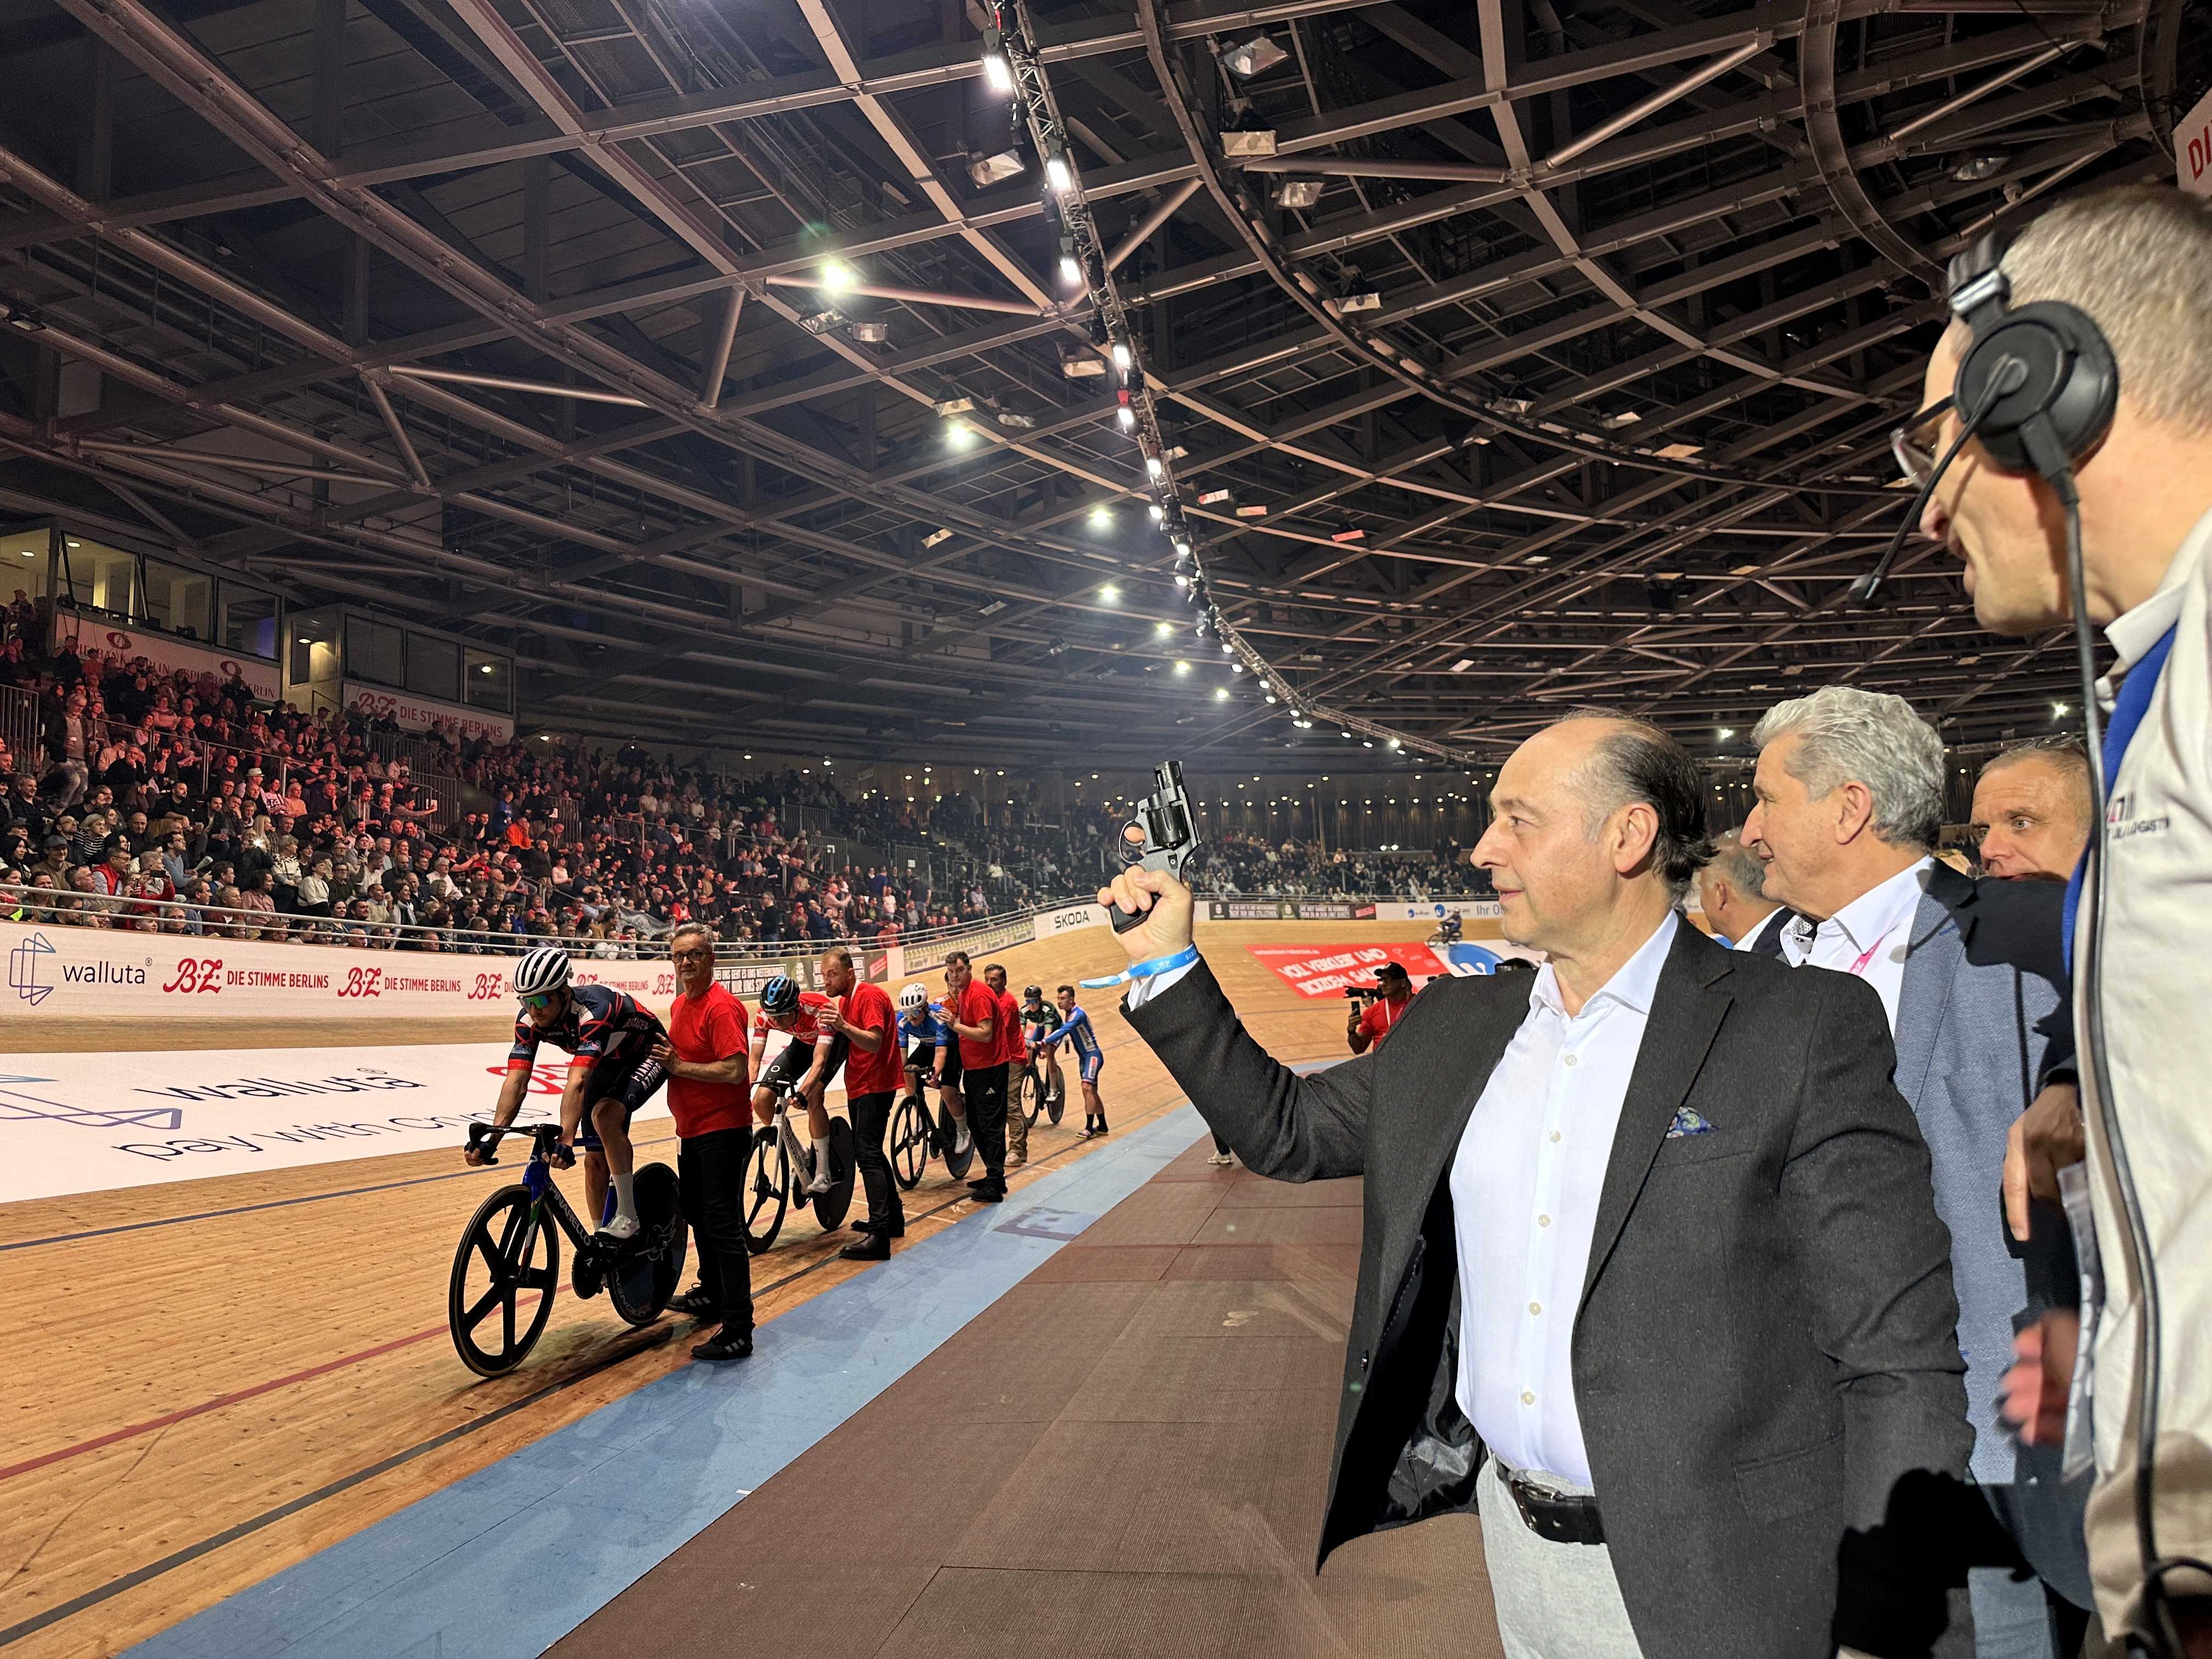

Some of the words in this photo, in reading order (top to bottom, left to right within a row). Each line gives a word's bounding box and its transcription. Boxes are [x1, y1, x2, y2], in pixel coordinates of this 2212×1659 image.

[2188, 119, 2212, 181] DI
[400, 706, 417, 721] DIE
[1476, 904, 1489, 915] Ihr
[1353, 948, 1387, 963] UND
[227, 970, 245, 985] DIE
[248, 972, 286, 988] STIMME
[289, 973, 329, 989] BERLINS
[385, 977, 398, 990] DIE
[400, 978, 428, 992] STIMME
[431, 979, 461, 992] BERLINS
[628, 980, 648, 991] BERLINS
[110, 1136, 264, 1161] pay
[250, 1122, 382, 1143] with
[549, 1182, 591, 1246] PINARELLO
